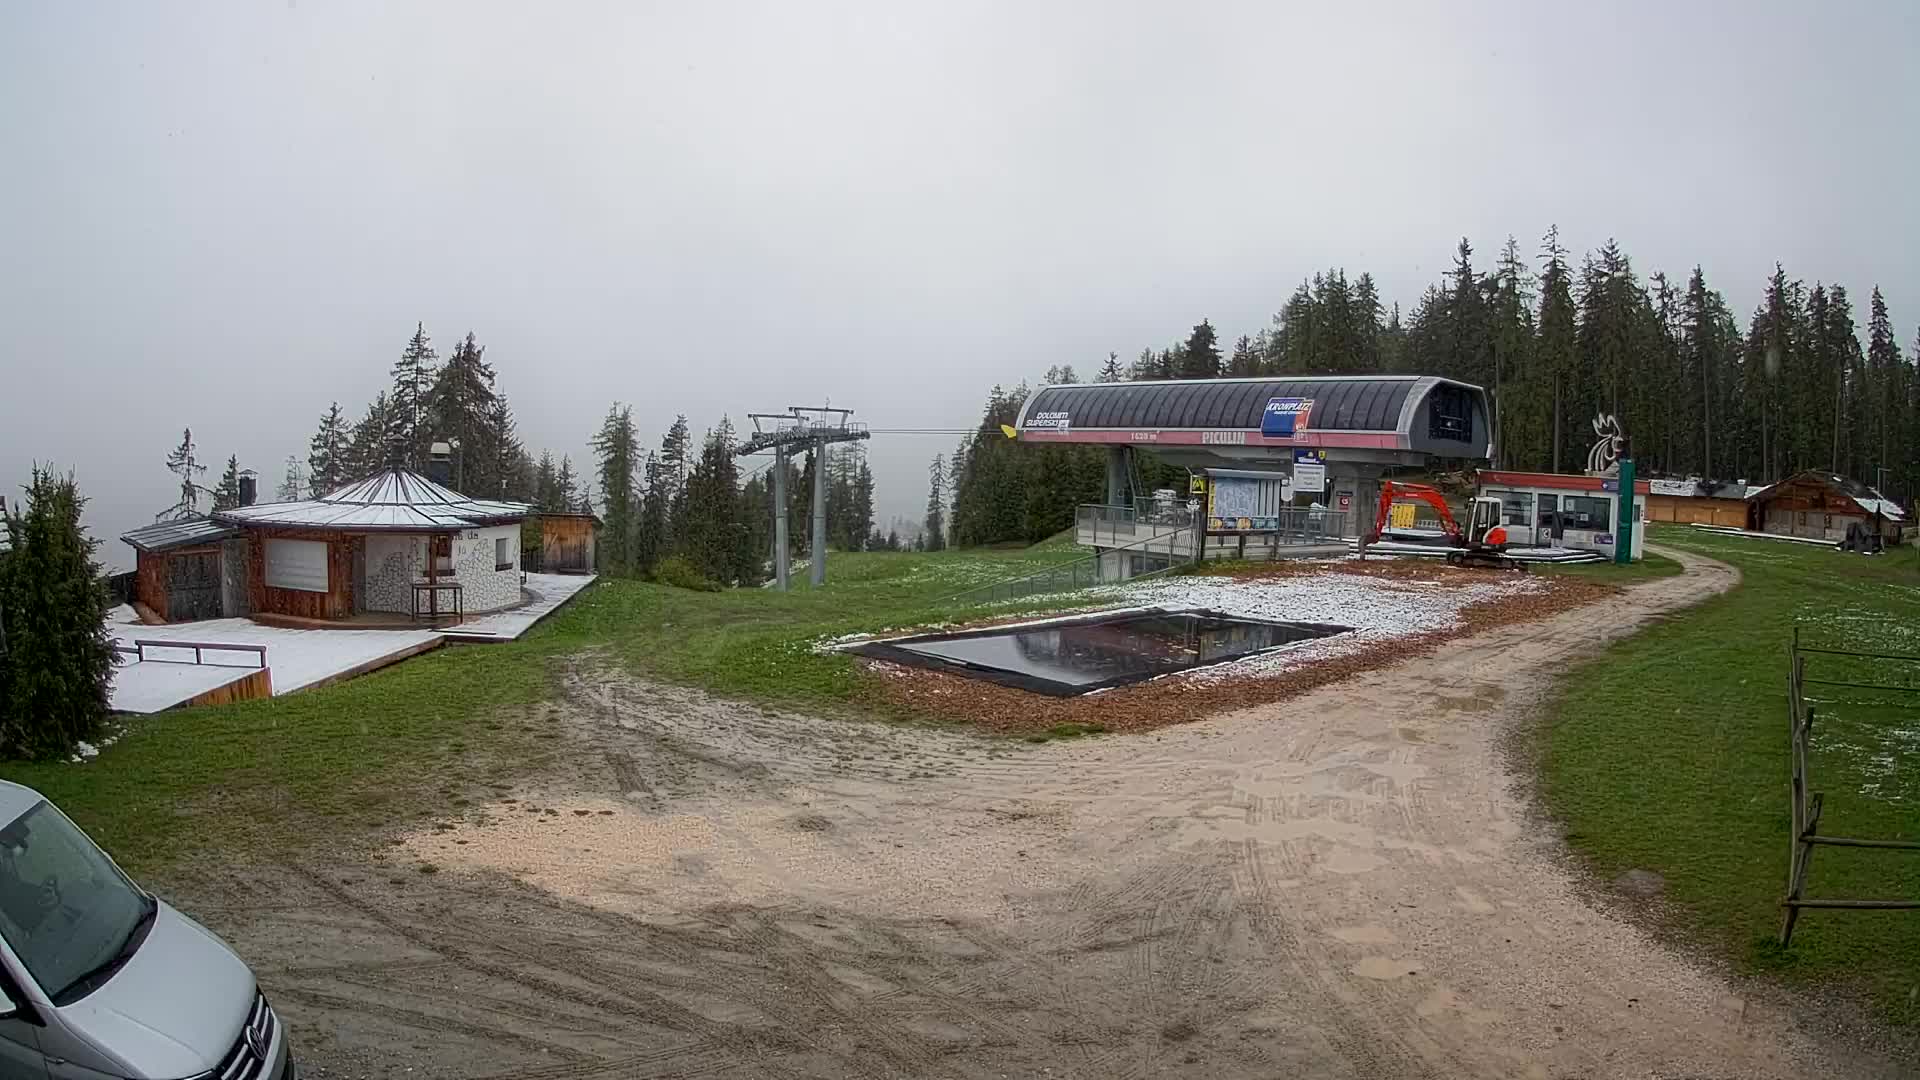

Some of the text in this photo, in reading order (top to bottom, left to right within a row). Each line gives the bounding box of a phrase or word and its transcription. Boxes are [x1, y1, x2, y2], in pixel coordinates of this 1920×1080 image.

[1265, 402, 1312, 411] KRONPLATZ
[1036, 411, 1069, 419] DOLOMITI
[1025, 419, 1059, 427] SUPERSKI
[1201, 431, 1245, 444] PICULIN
